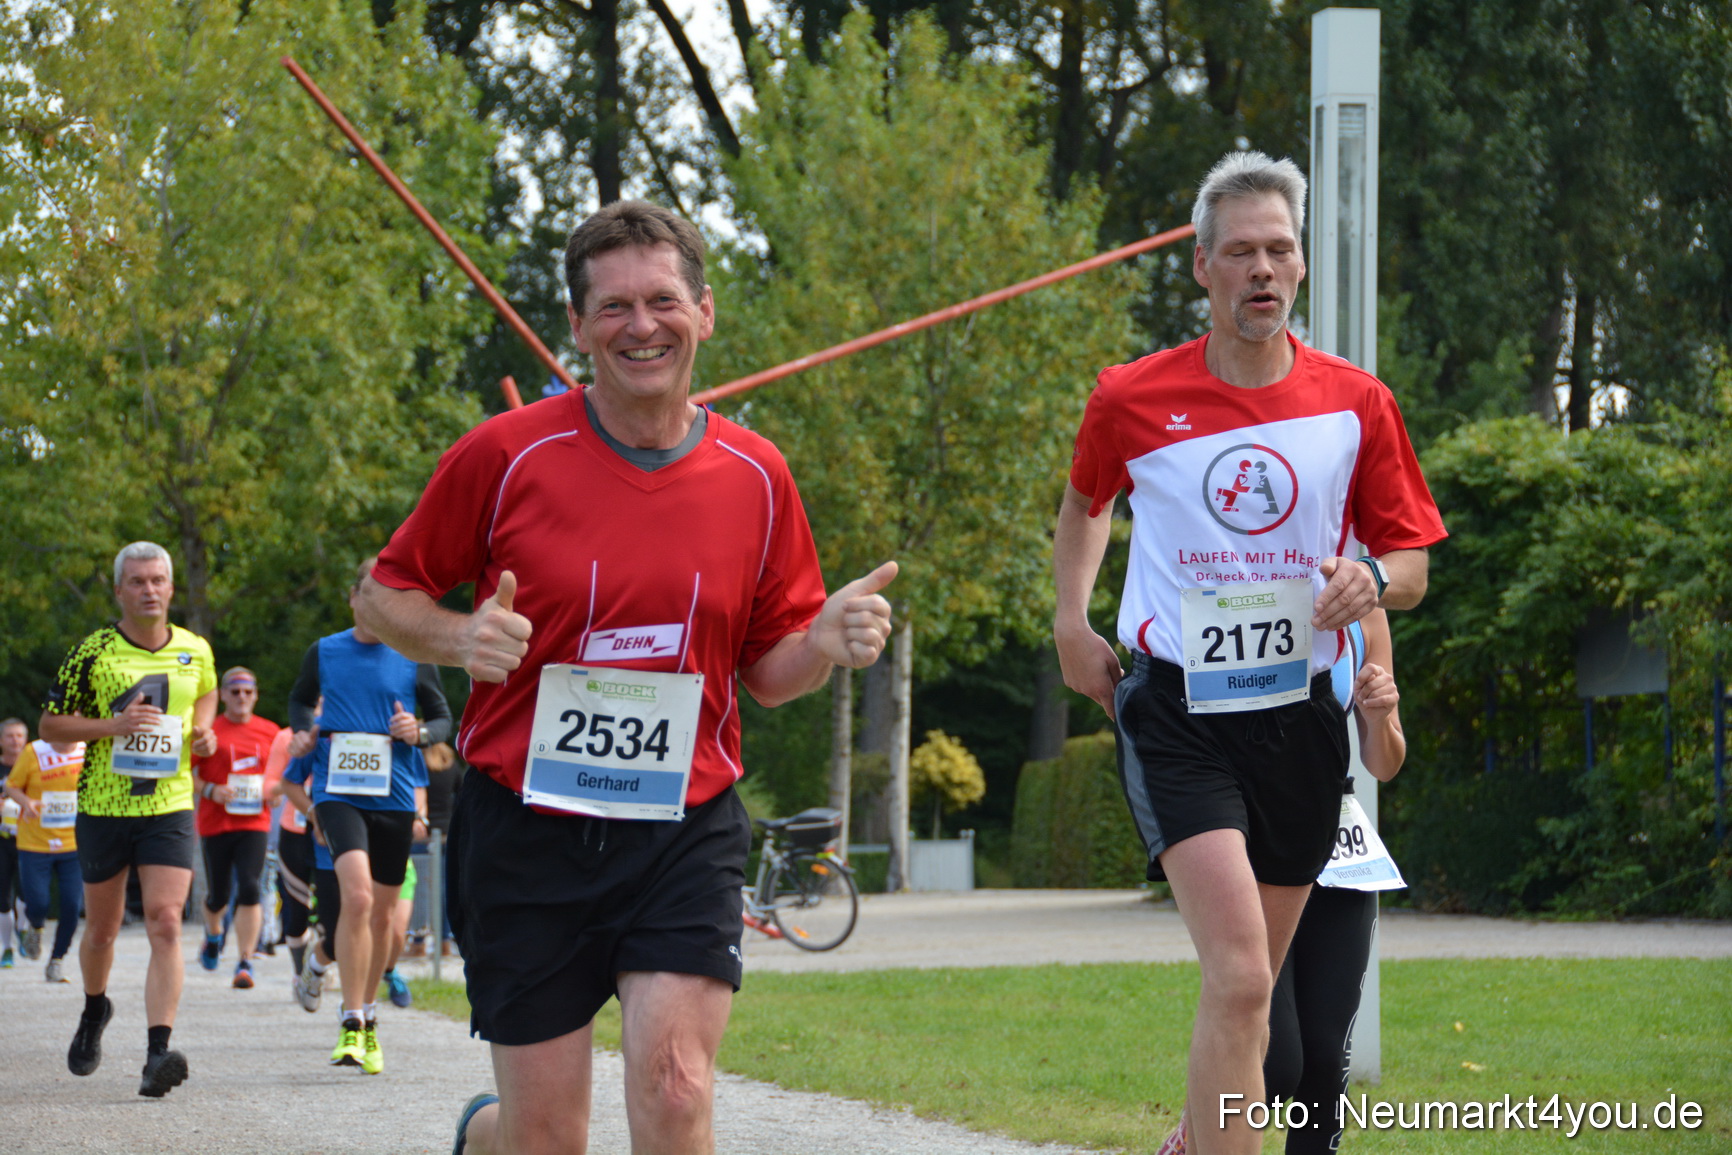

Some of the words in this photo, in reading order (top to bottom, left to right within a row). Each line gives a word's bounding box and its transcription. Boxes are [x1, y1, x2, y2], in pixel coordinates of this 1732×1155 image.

[1166, 422, 1192, 431] erima
[1230, 592, 1276, 607] BOCK
[611, 635, 656, 651] DEHN
[1201, 618, 1294, 664] 2173
[603, 681, 657, 698] BOCK
[1227, 673, 1278, 690] Rüdiger
[123, 733, 172, 753] 2675
[555, 709, 670, 762] 2534
[338, 752, 381, 771] 2585
[577, 771, 640, 792] Gerhard
[1333, 867, 1372, 880] Veronika
